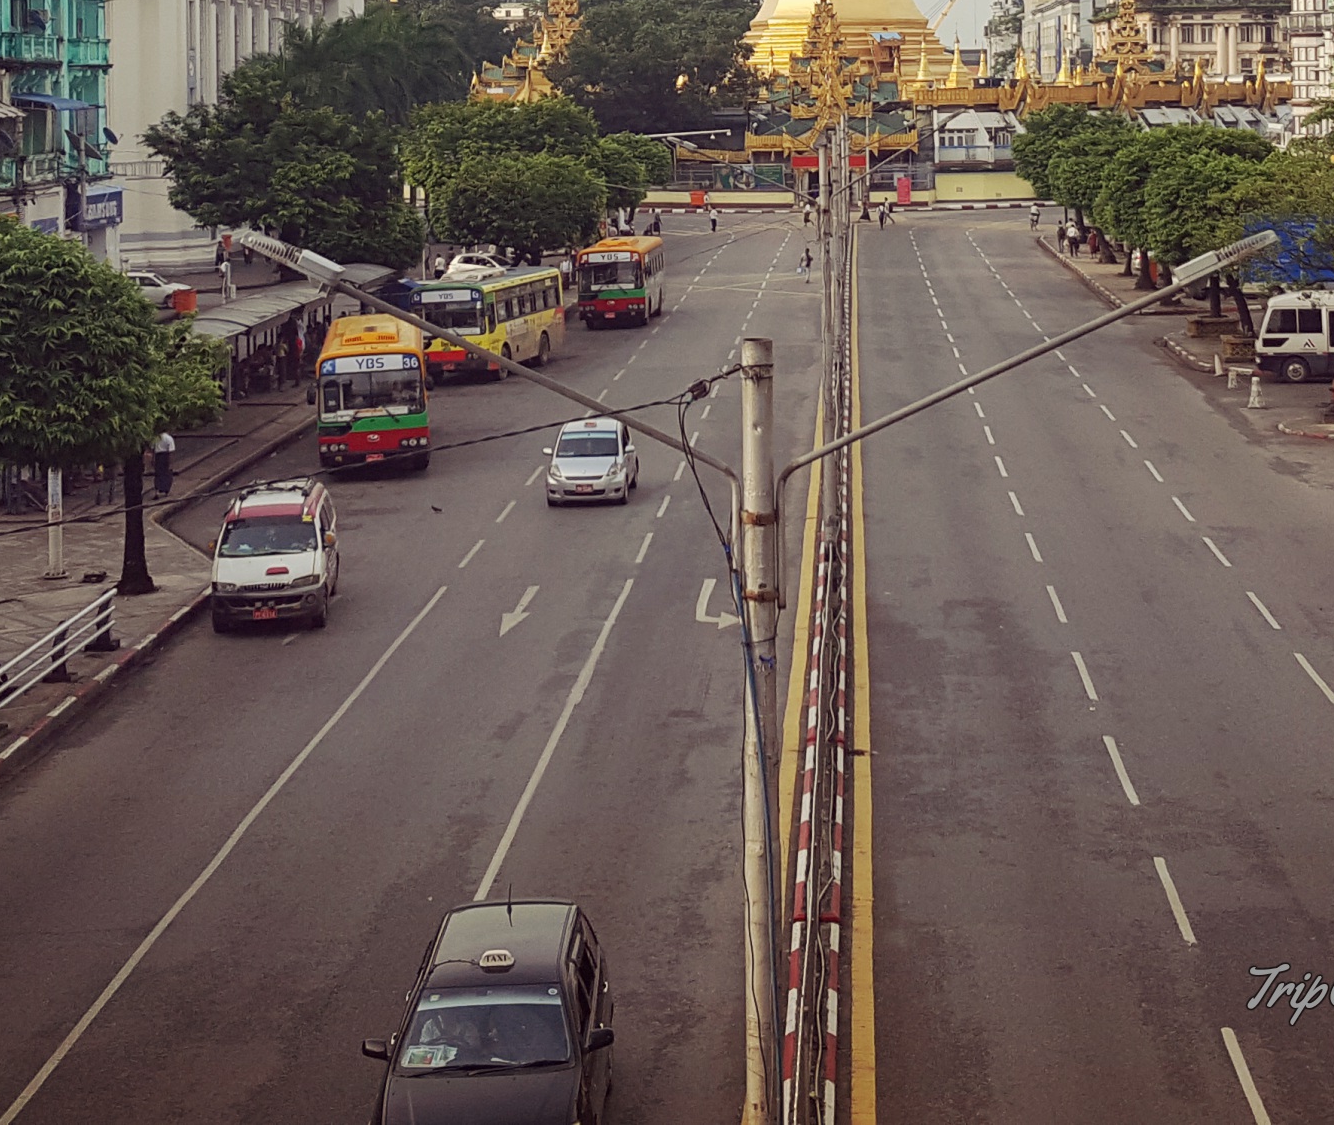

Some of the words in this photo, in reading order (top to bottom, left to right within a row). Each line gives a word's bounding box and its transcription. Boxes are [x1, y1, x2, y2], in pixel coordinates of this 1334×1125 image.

[355, 357, 385, 370] YBS
[403, 356, 419, 368] 36
[483, 954, 507, 963] TAXI
